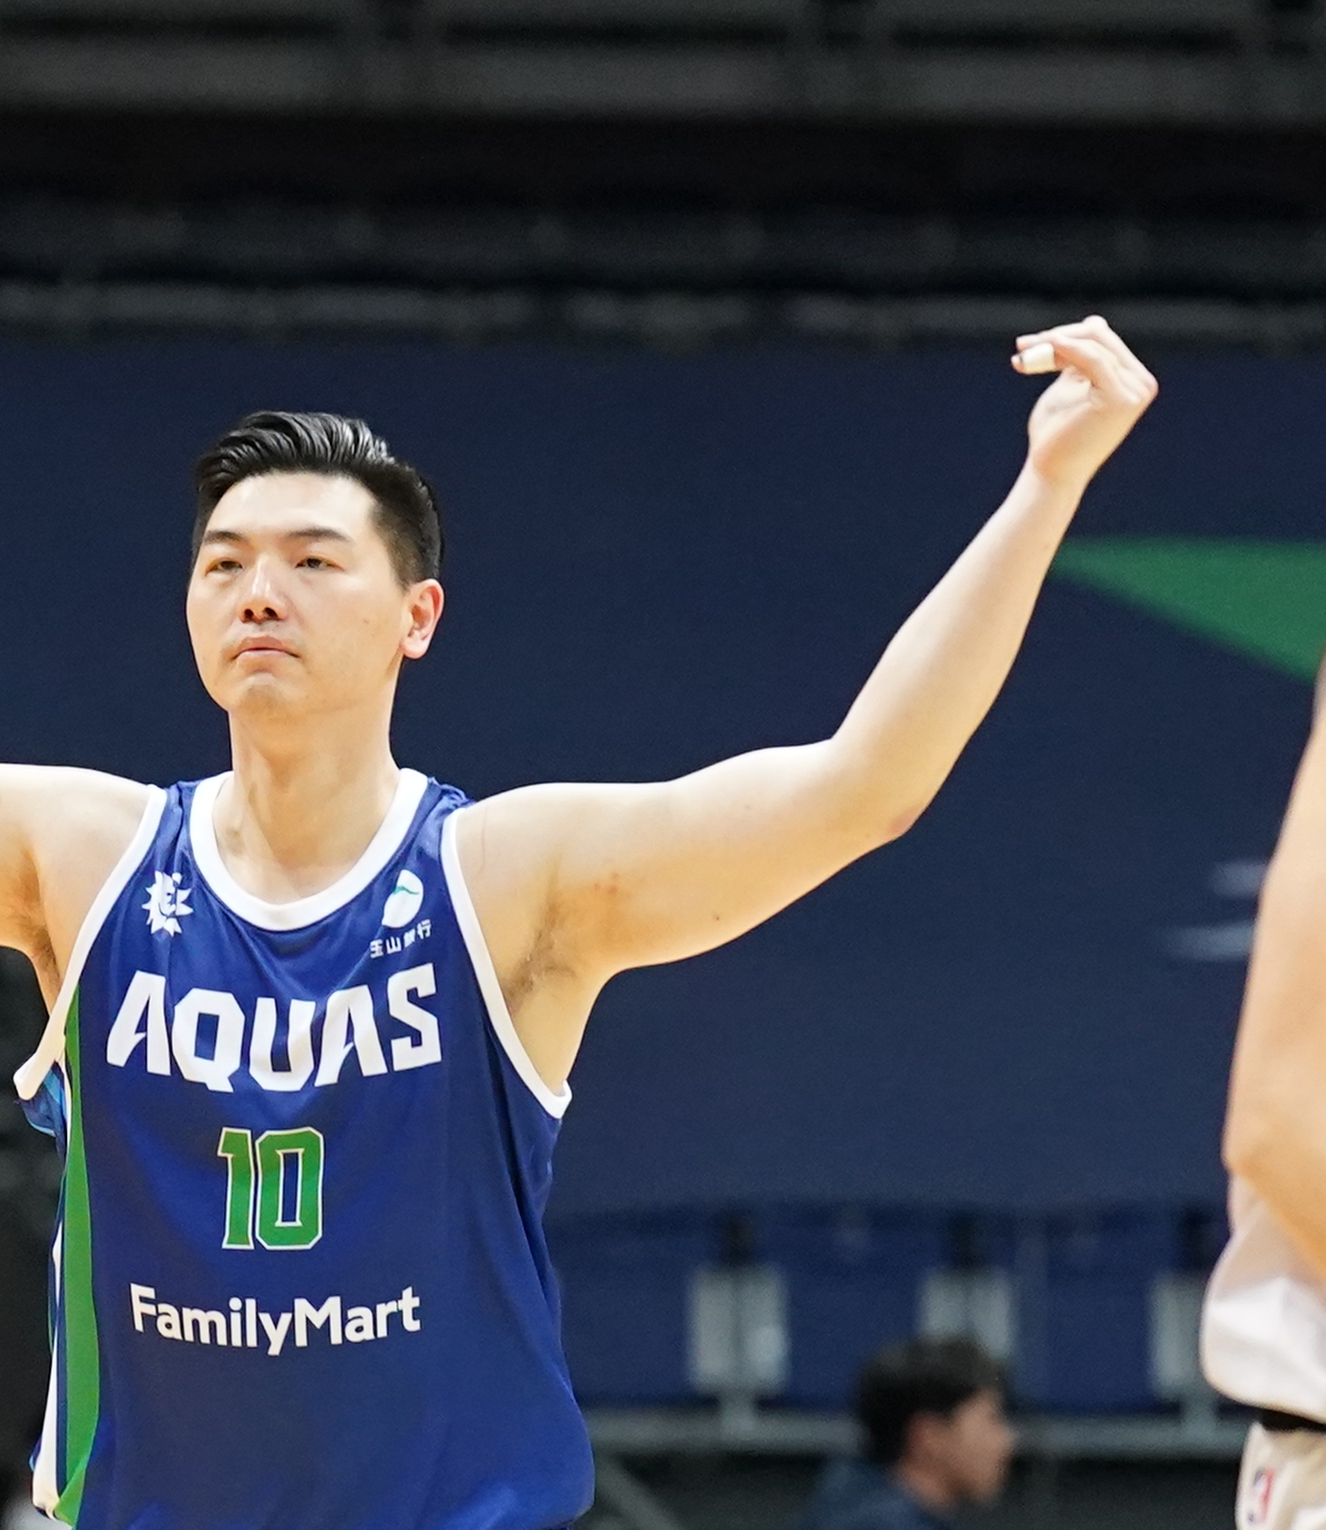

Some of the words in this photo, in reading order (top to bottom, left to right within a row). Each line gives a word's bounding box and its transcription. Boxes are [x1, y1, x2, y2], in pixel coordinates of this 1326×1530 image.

[106, 962, 442, 1092] AQUAS
[217, 1126, 324, 1250] 10
[130, 1283, 421, 1355] FamilyMart
